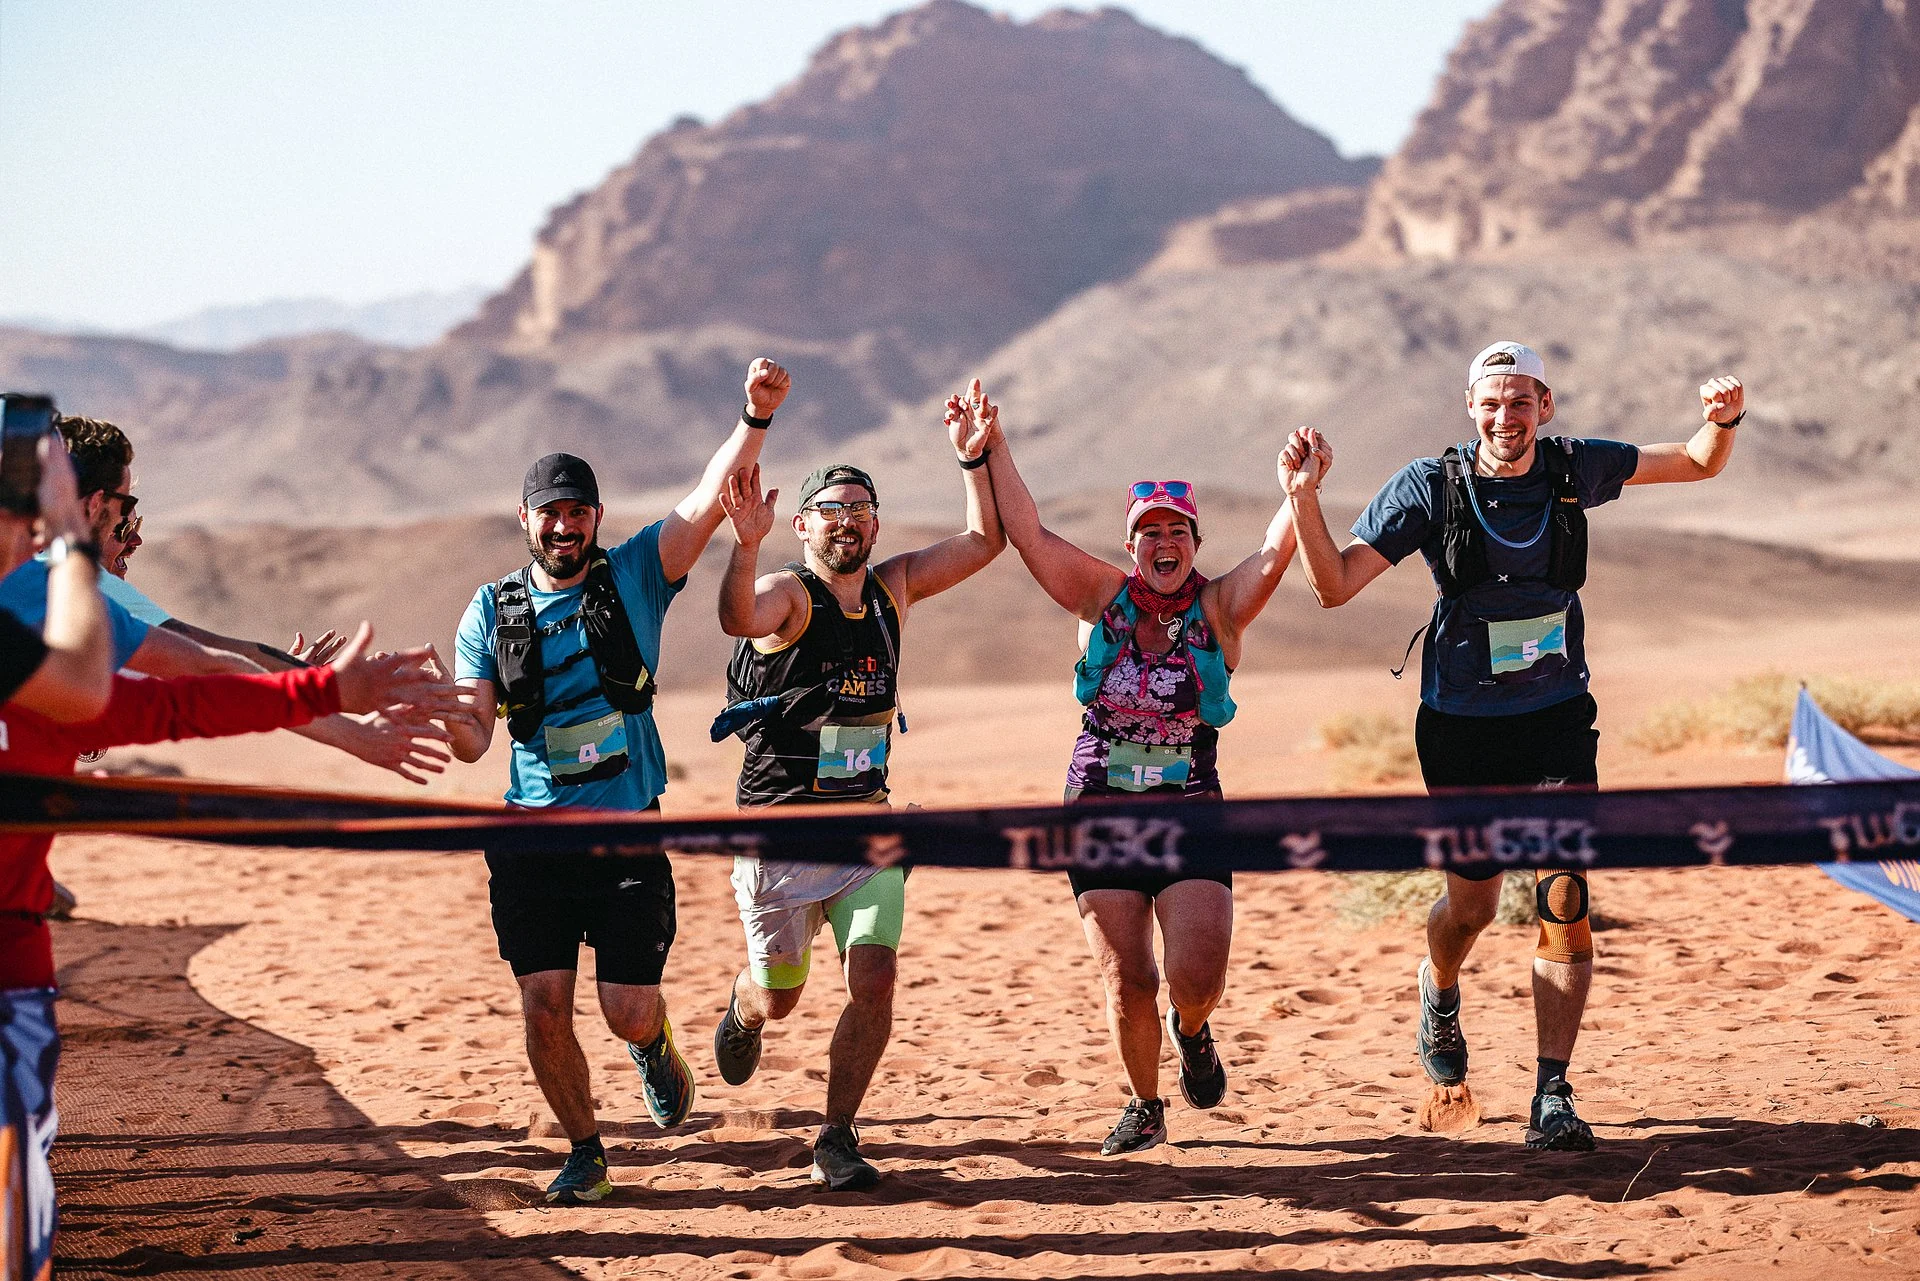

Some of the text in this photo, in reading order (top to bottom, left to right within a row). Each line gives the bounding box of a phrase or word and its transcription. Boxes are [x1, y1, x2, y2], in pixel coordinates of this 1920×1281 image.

[1522, 639, 1540, 662] 5
[826, 678, 887, 697] GAMES
[578, 743, 600, 763] 4
[843, 748, 871, 772] 16
[1131, 765, 1163, 786] 15
